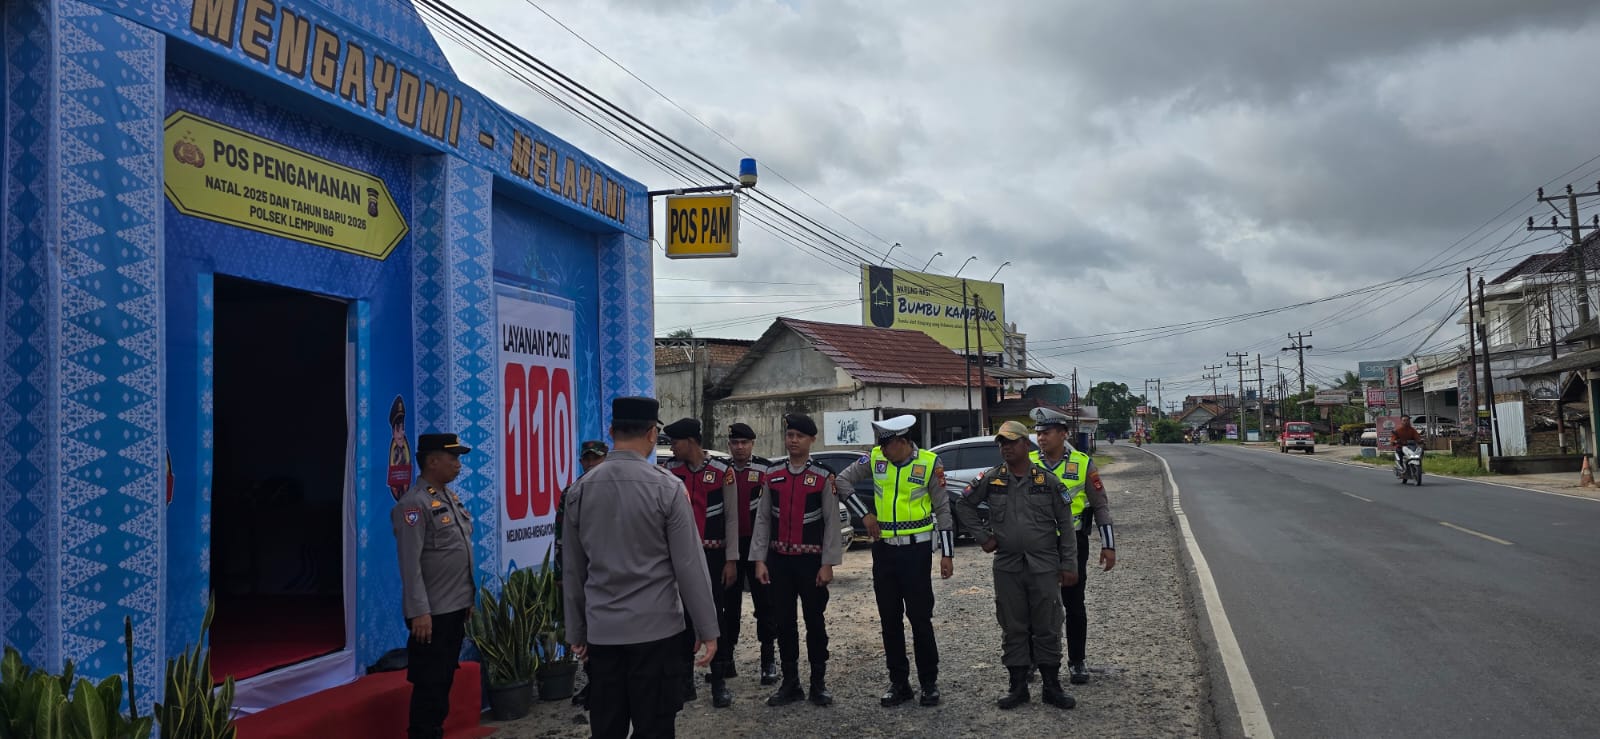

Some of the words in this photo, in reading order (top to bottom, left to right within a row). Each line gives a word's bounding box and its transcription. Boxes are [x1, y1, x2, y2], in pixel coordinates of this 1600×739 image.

[189, 0, 462, 148] MENGAYOMI
[510, 128, 625, 224] MELAYANI
[213, 139, 249, 171] POS
[253, 152, 361, 205] PENGAMANAN
[205, 175, 241, 197] NATAL
[243, 186, 267, 203] 2025
[269, 193, 290, 210] DAN
[291, 199, 321, 218] TAHUN
[323, 208, 346, 224] BARU
[347, 215, 366, 230] 2026
[250, 205, 287, 226] POLSEK
[289, 216, 334, 237] LEMPUING
[671, 207, 697, 244] POS
[701, 206, 730, 244] PAM
[898, 297, 940, 316] BUMBU
[945, 305, 996, 321] KAMPUNG
[502, 323, 544, 356] LAYANAN
[546, 331, 570, 360] POLISI
[506, 378, 571, 505] 110
